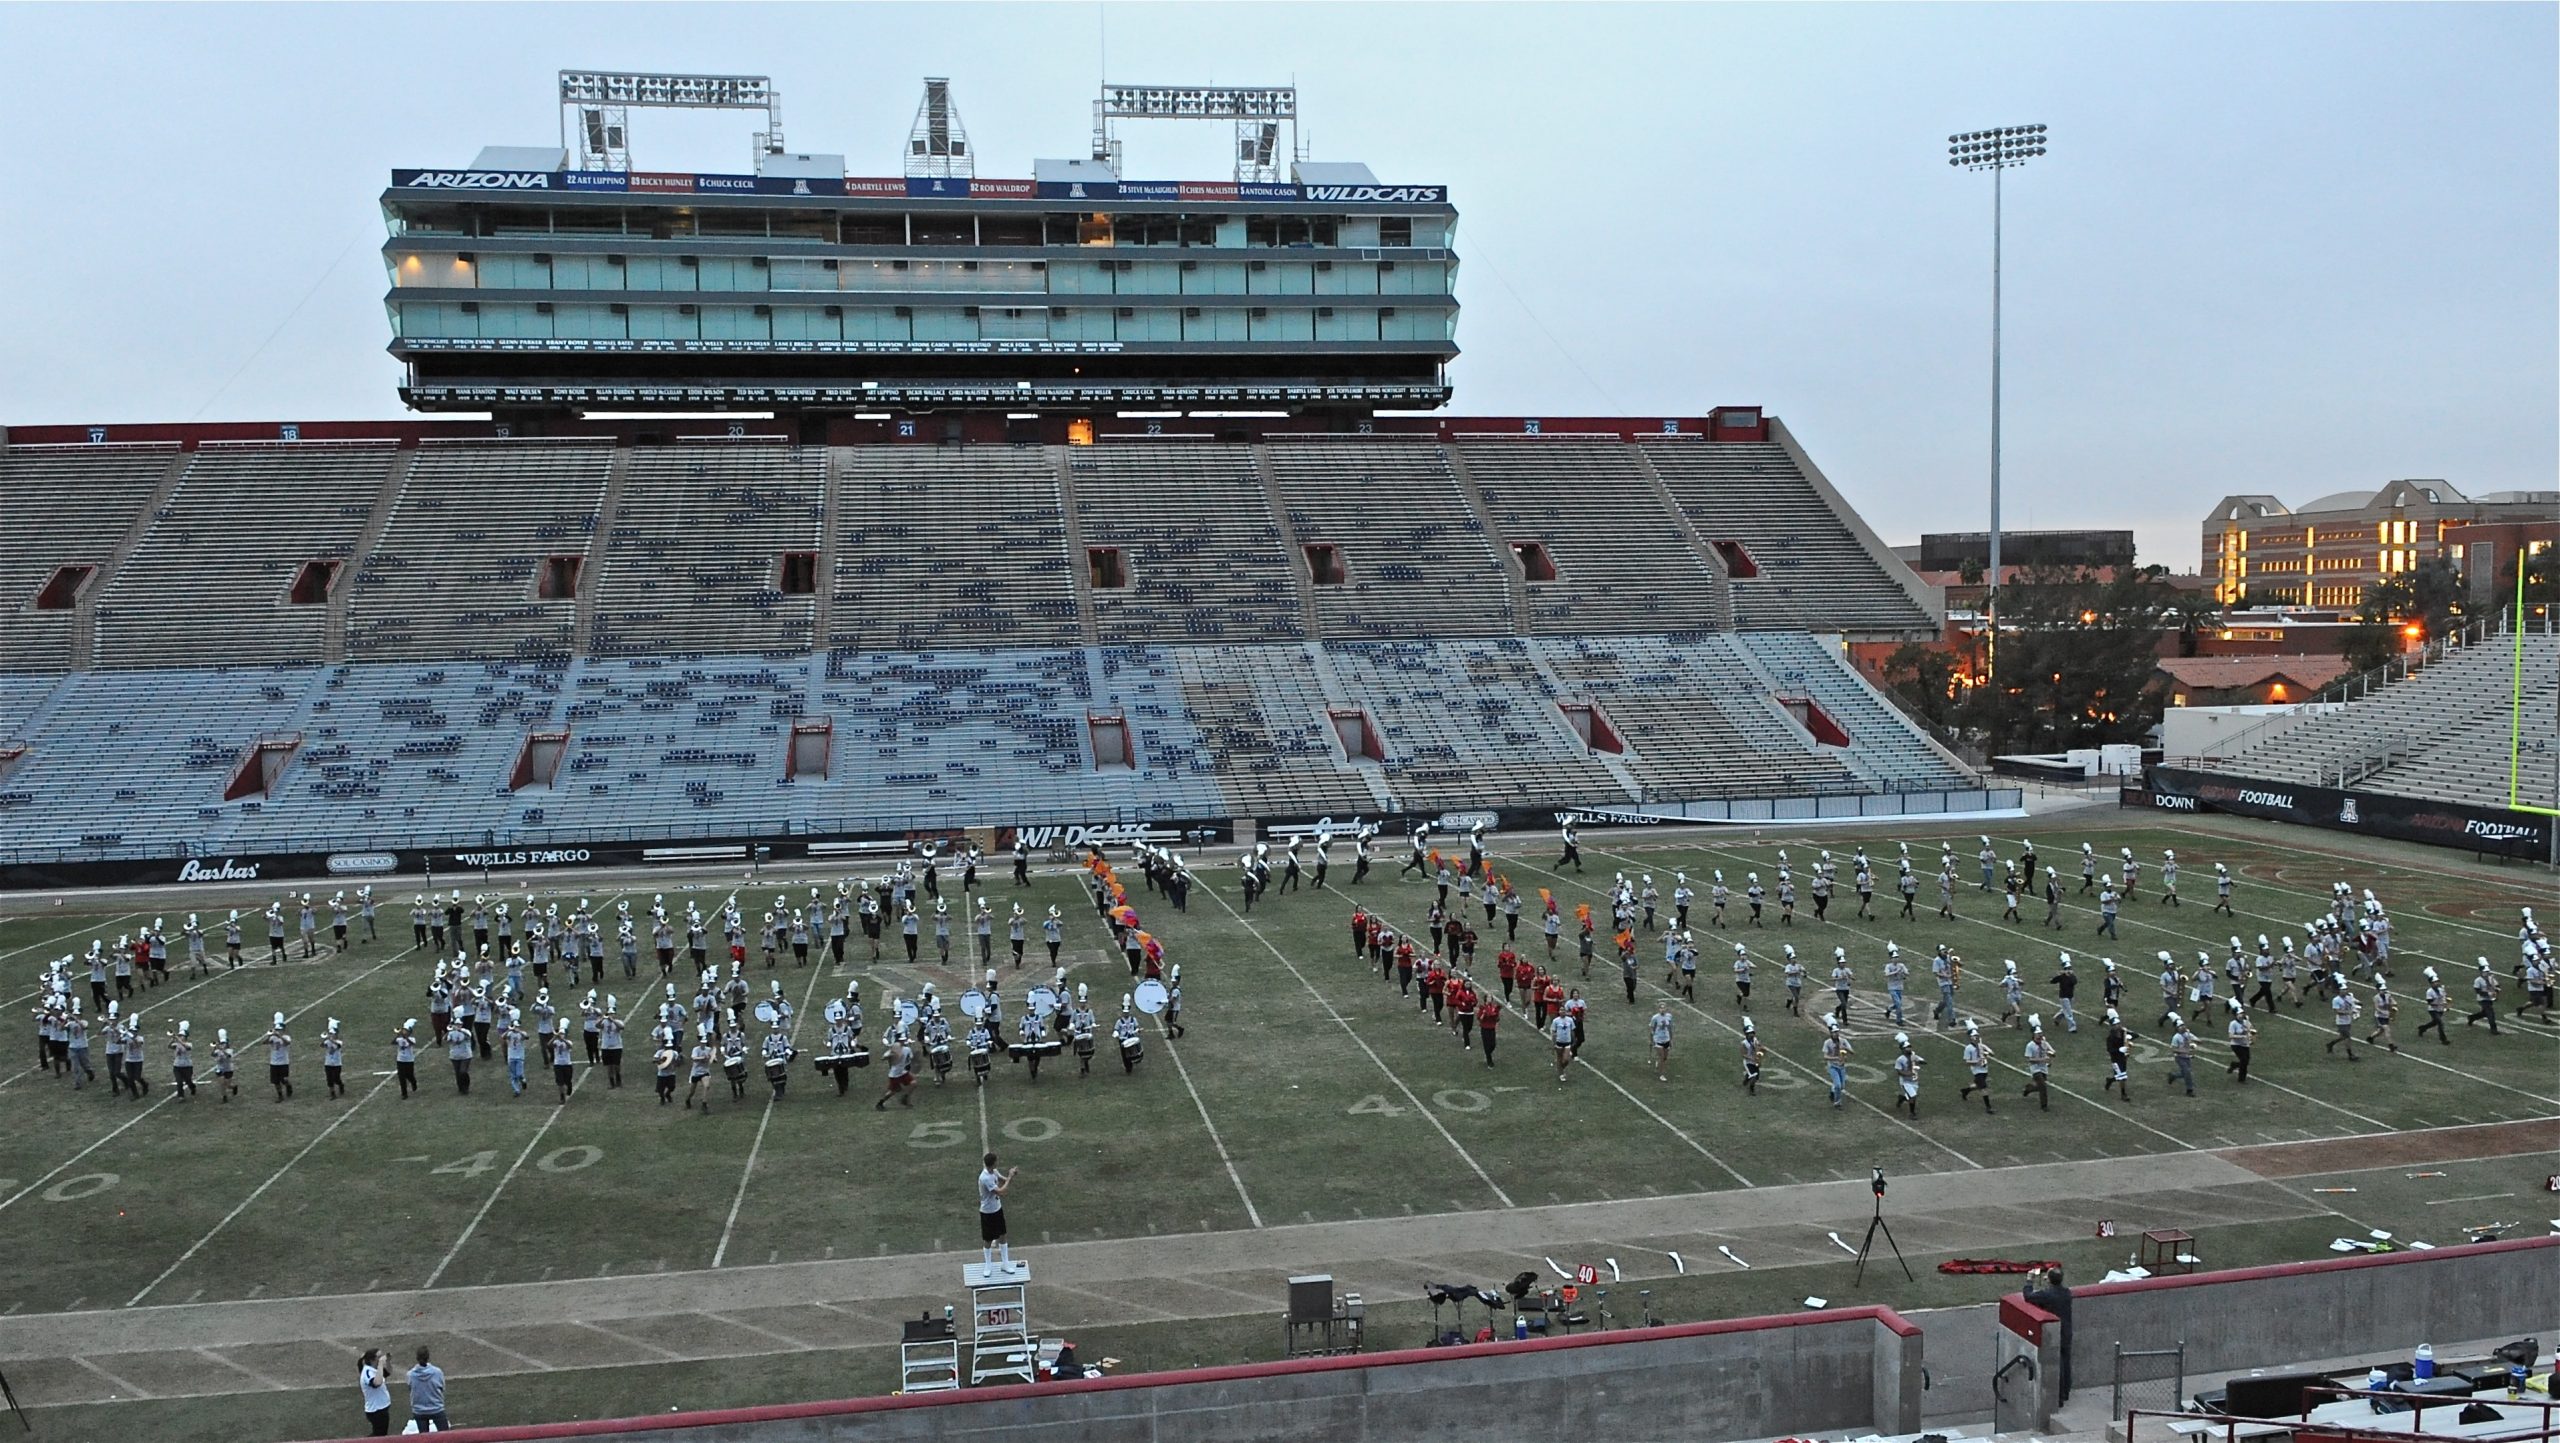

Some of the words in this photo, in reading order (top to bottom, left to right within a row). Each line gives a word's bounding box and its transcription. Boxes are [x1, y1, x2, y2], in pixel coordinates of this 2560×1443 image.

[408, 172, 549, 188] ARIZONA
[567, 175, 578, 184] 22
[577, 176, 588, 185] ART
[592, 177, 626, 185] LUPPINO
[641, 177, 663, 186] RICKY
[664, 178, 694, 187] HUNLEY
[699, 177, 706, 186] 6
[706, 179, 732, 188] CHUCK
[732, 180, 755, 189] CECIL
[845, 182, 851, 191] 4
[851, 183, 883, 192] DARRYLL
[884, 183, 907, 193] LEWIS
[980, 184, 996, 193] ROB
[996, 185, 1031, 194] WALDROP
[1118, 185, 1128, 194] 28
[1127, 186, 1144, 194] STEVE
[1144, 186, 1179, 195] McLAUGHLIN
[1179, 185, 1187, 195] 11
[1186, 186, 1205, 195] CHRIS
[1206, 186, 1239, 195] McALISTER
[1245, 187, 1273, 196] ANTOINE
[1273, 187, 1297, 196] CASON
[1305, 186, 1440, 202] WILDCATS
[496, 428, 510, 438] 19
[728, 426, 744, 437] 20
[900, 425, 913, 436] 21
[1147, 424, 1161, 435] 22
[1359, 423, 1373, 434] 23
[1525, 424, 1539, 434] 24
[1664, 424, 1678, 434] 25
[91, 432, 105, 443] 17
[283, 431, 297, 441] 18
[2155, 793, 2195, 810] DOWN
[2238, 789, 2293, 810] FOOTBALL
[1610, 814, 1661, 825] FARGO
[331, 859, 350, 868] SOL
[351, 857, 391, 867] CASINOS
[463, 852, 527, 866] WELLS
[529, 848, 591, 864] FARGO
[177, 859, 261, 882] Bashas'
[1346, 1088, 1495, 1119] 40
[905, 1116, 1063, 1149] 50
[430, 1145, 604, 1179] 40
[2099, 1220, 2114, 1238] 30
[1578, 1265, 1594, 1283] 40
[990, 1308, 1009, 1325] 50
